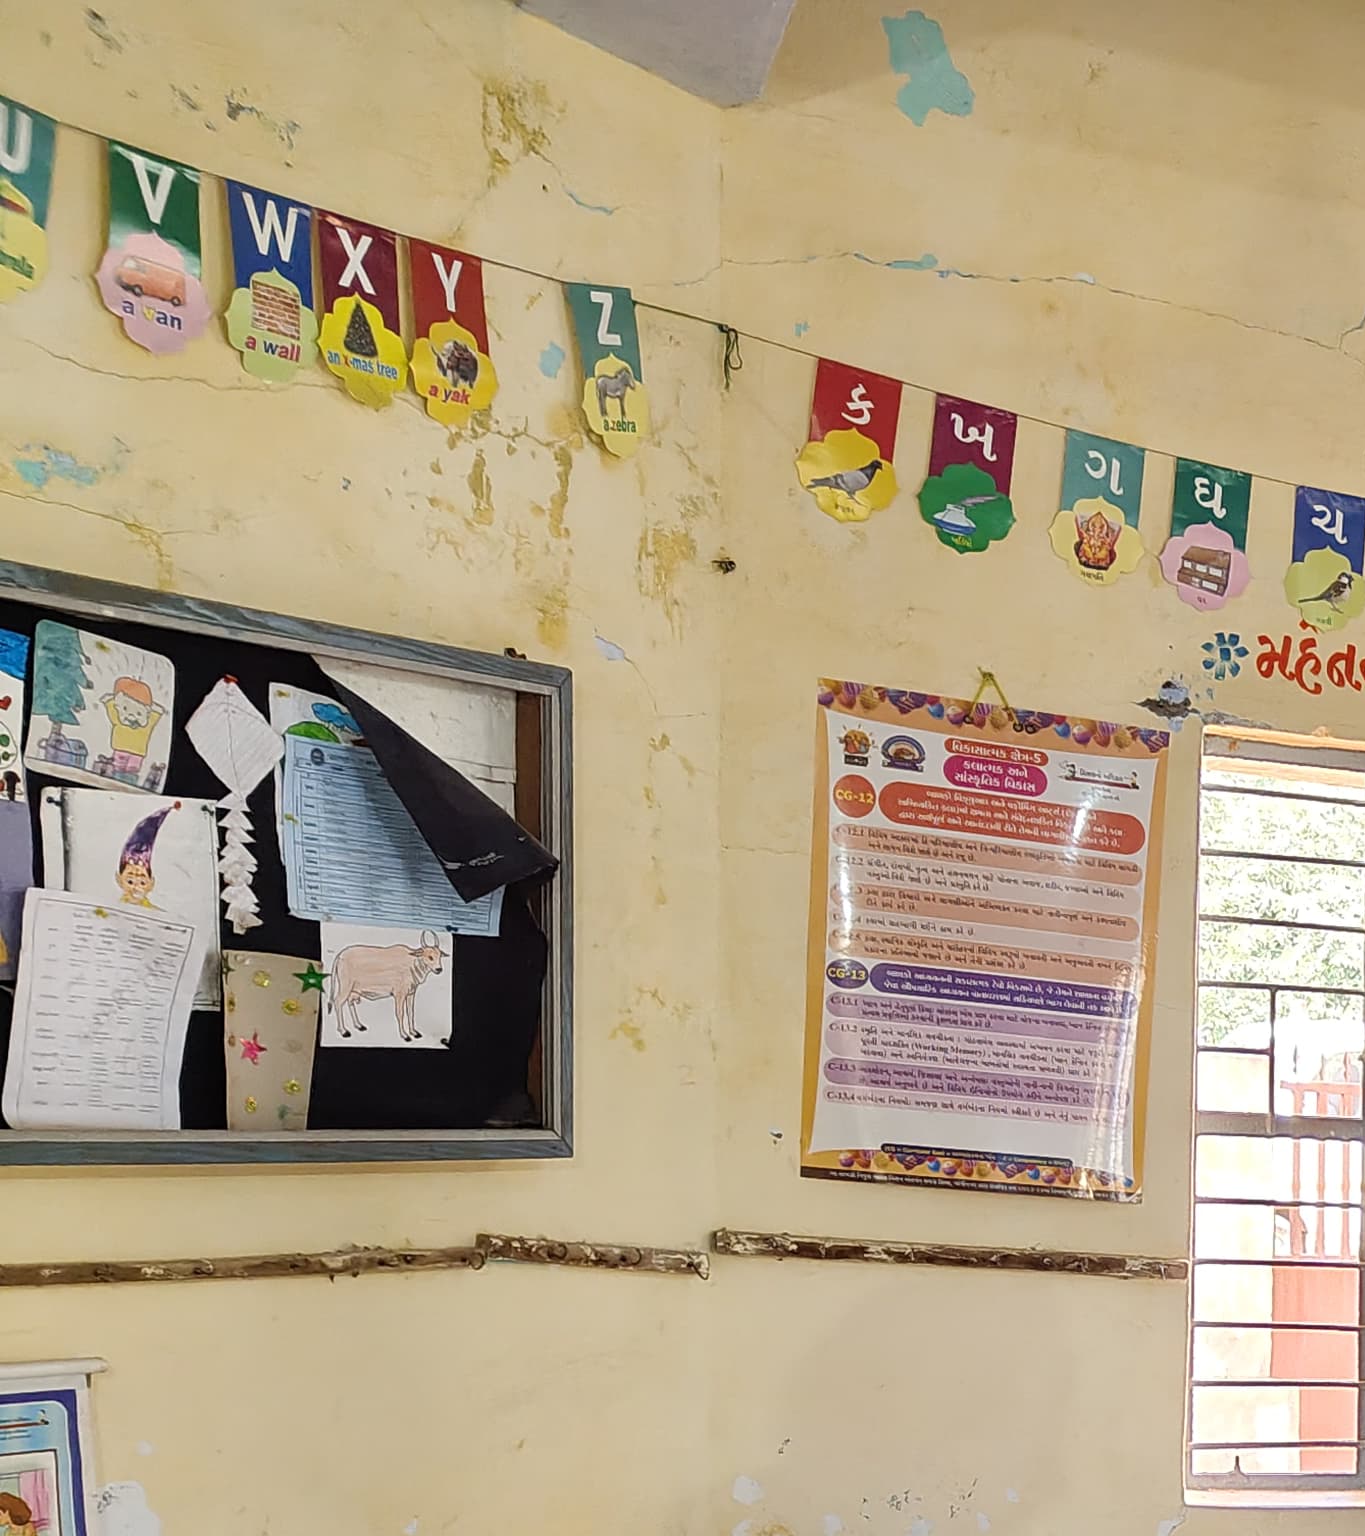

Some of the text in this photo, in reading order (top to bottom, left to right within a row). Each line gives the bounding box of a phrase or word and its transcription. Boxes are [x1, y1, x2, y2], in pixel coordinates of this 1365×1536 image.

[132, 157, 176, 225] V
[241, 191, 298, 263] W
[335, 227, 376, 295] X
[431, 252, 463, 312] Y
[122, 299, 183, 331] a van
[590, 291, 622, 346] Z
[245, 335, 301, 363] a wall
[327, 350, 397, 380] an x-mas tree
[429, 385, 471, 405] a yak
[841, 383, 875, 425] ક
[603, 417, 637, 433] a zebra
[951, 412, 997, 462] ખ
[1084, 450, 1124, 496] ગ
[1194, 477, 1227, 519] ઘ
[1311, 505, 1348, 545] ચ
[1005, 776, 1036, 792] વિકાસ
[1008, 767, 1028, 778] અને
[835, 788, 874, 804] CG-12
[828, 968, 865, 980] CG-13
